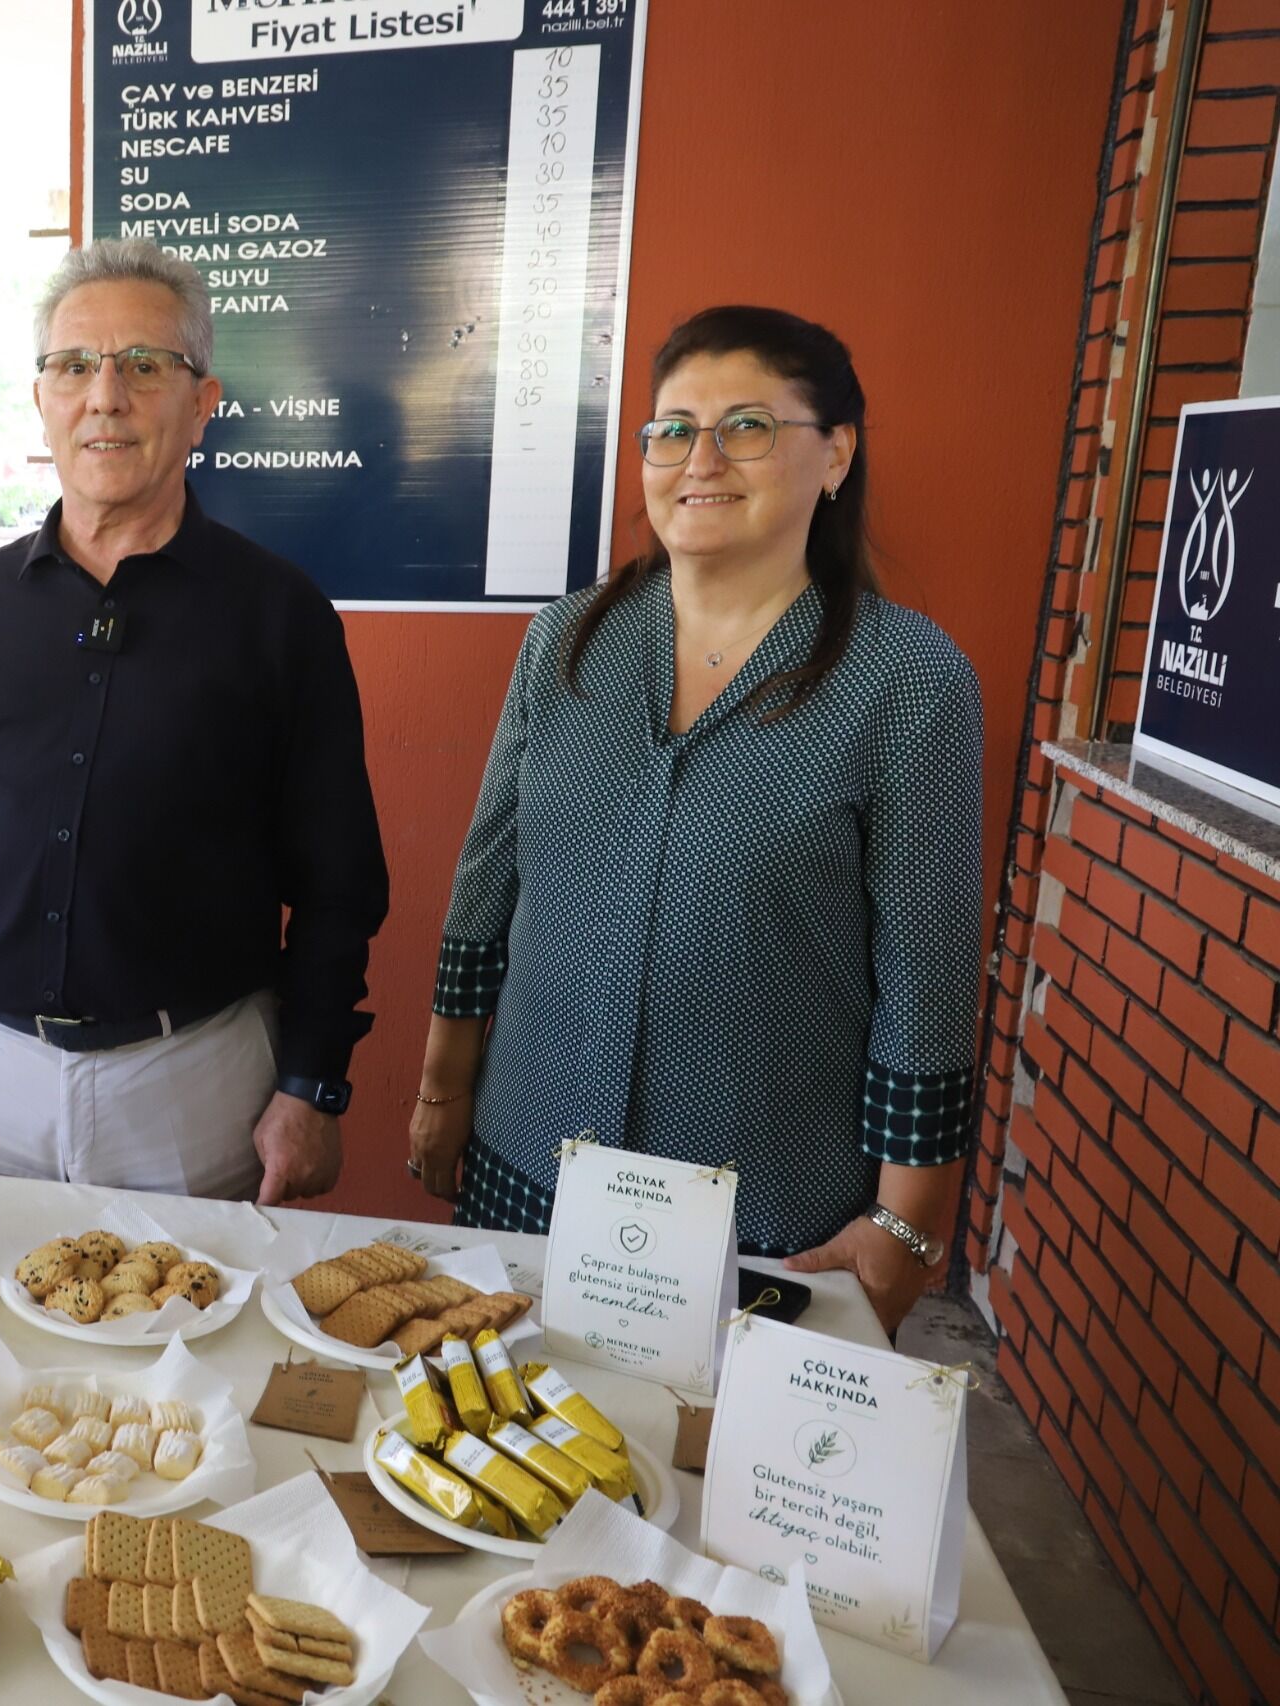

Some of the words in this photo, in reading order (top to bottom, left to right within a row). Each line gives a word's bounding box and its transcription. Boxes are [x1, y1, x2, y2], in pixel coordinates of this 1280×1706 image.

[542, 0, 575, 19] 444
[251, 17, 336, 52] Fiyat
[350, 5, 464, 40] Listesi
[542, 16, 624, 34] nazilli.bel.tr
[545, 47, 573, 71] 10
[121, 83, 176, 109] ÇAY
[183, 84, 214, 100] ve
[222, 68, 318, 98] BENZERİ
[538, 75, 569, 99] 35
[121, 108, 178, 132] TÜRK
[186, 99, 290, 128] KAHVESİ
[536, 104, 568, 128] 35
[121, 135, 230, 159] NESCAFE
[540, 132, 566, 156] 10
[121, 167, 150, 185] SU
[535, 161, 564, 185] 30
[120, 192, 191, 212] SODA
[533, 193, 563, 214] 35
[121, 213, 219, 238] MEYVELİ
[227, 213, 300, 234] SODA
[536, 220, 561, 242] 40
[162, 243, 230, 262] DRAN
[238, 239, 327, 259] GAZOZ
[528, 249, 561, 268] 25
[208, 268, 269, 288] SUYU
[528, 277, 557, 296] 50
[210, 295, 289, 314] FANTA
[523, 302, 552, 323] 50
[270, 395, 340, 421] VİŞNE
[216, 450, 363, 469] DONDURMA
[1190, 624, 1203, 644] T.C.
[616, 1170, 666, 1189] ÇÖLYAK
[607, 1183, 673, 1205] HAKKINDA
[581, 1254, 624, 1274] Çapraz
[628, 1264, 680, 1287] bulaşma
[569, 1271, 623, 1290] glutensiz
[626, 1282, 687, 1306] ürünlerde
[803, 1359, 870, 1387] ÇÖLYAK
[789, 1373, 878, 1409] HAKKINDA
[752, 1464, 826, 1499] Glutensiz
[832, 1492, 883, 1517] yaşam
[754, 1486, 776, 1503] bir
[782, 1496, 828, 1521] tercih
[835, 1509, 881, 1541] değil,
[748, 1505, 820, 1543] ihtiyaç
[825, 1535, 882, 1563] olabilir.
